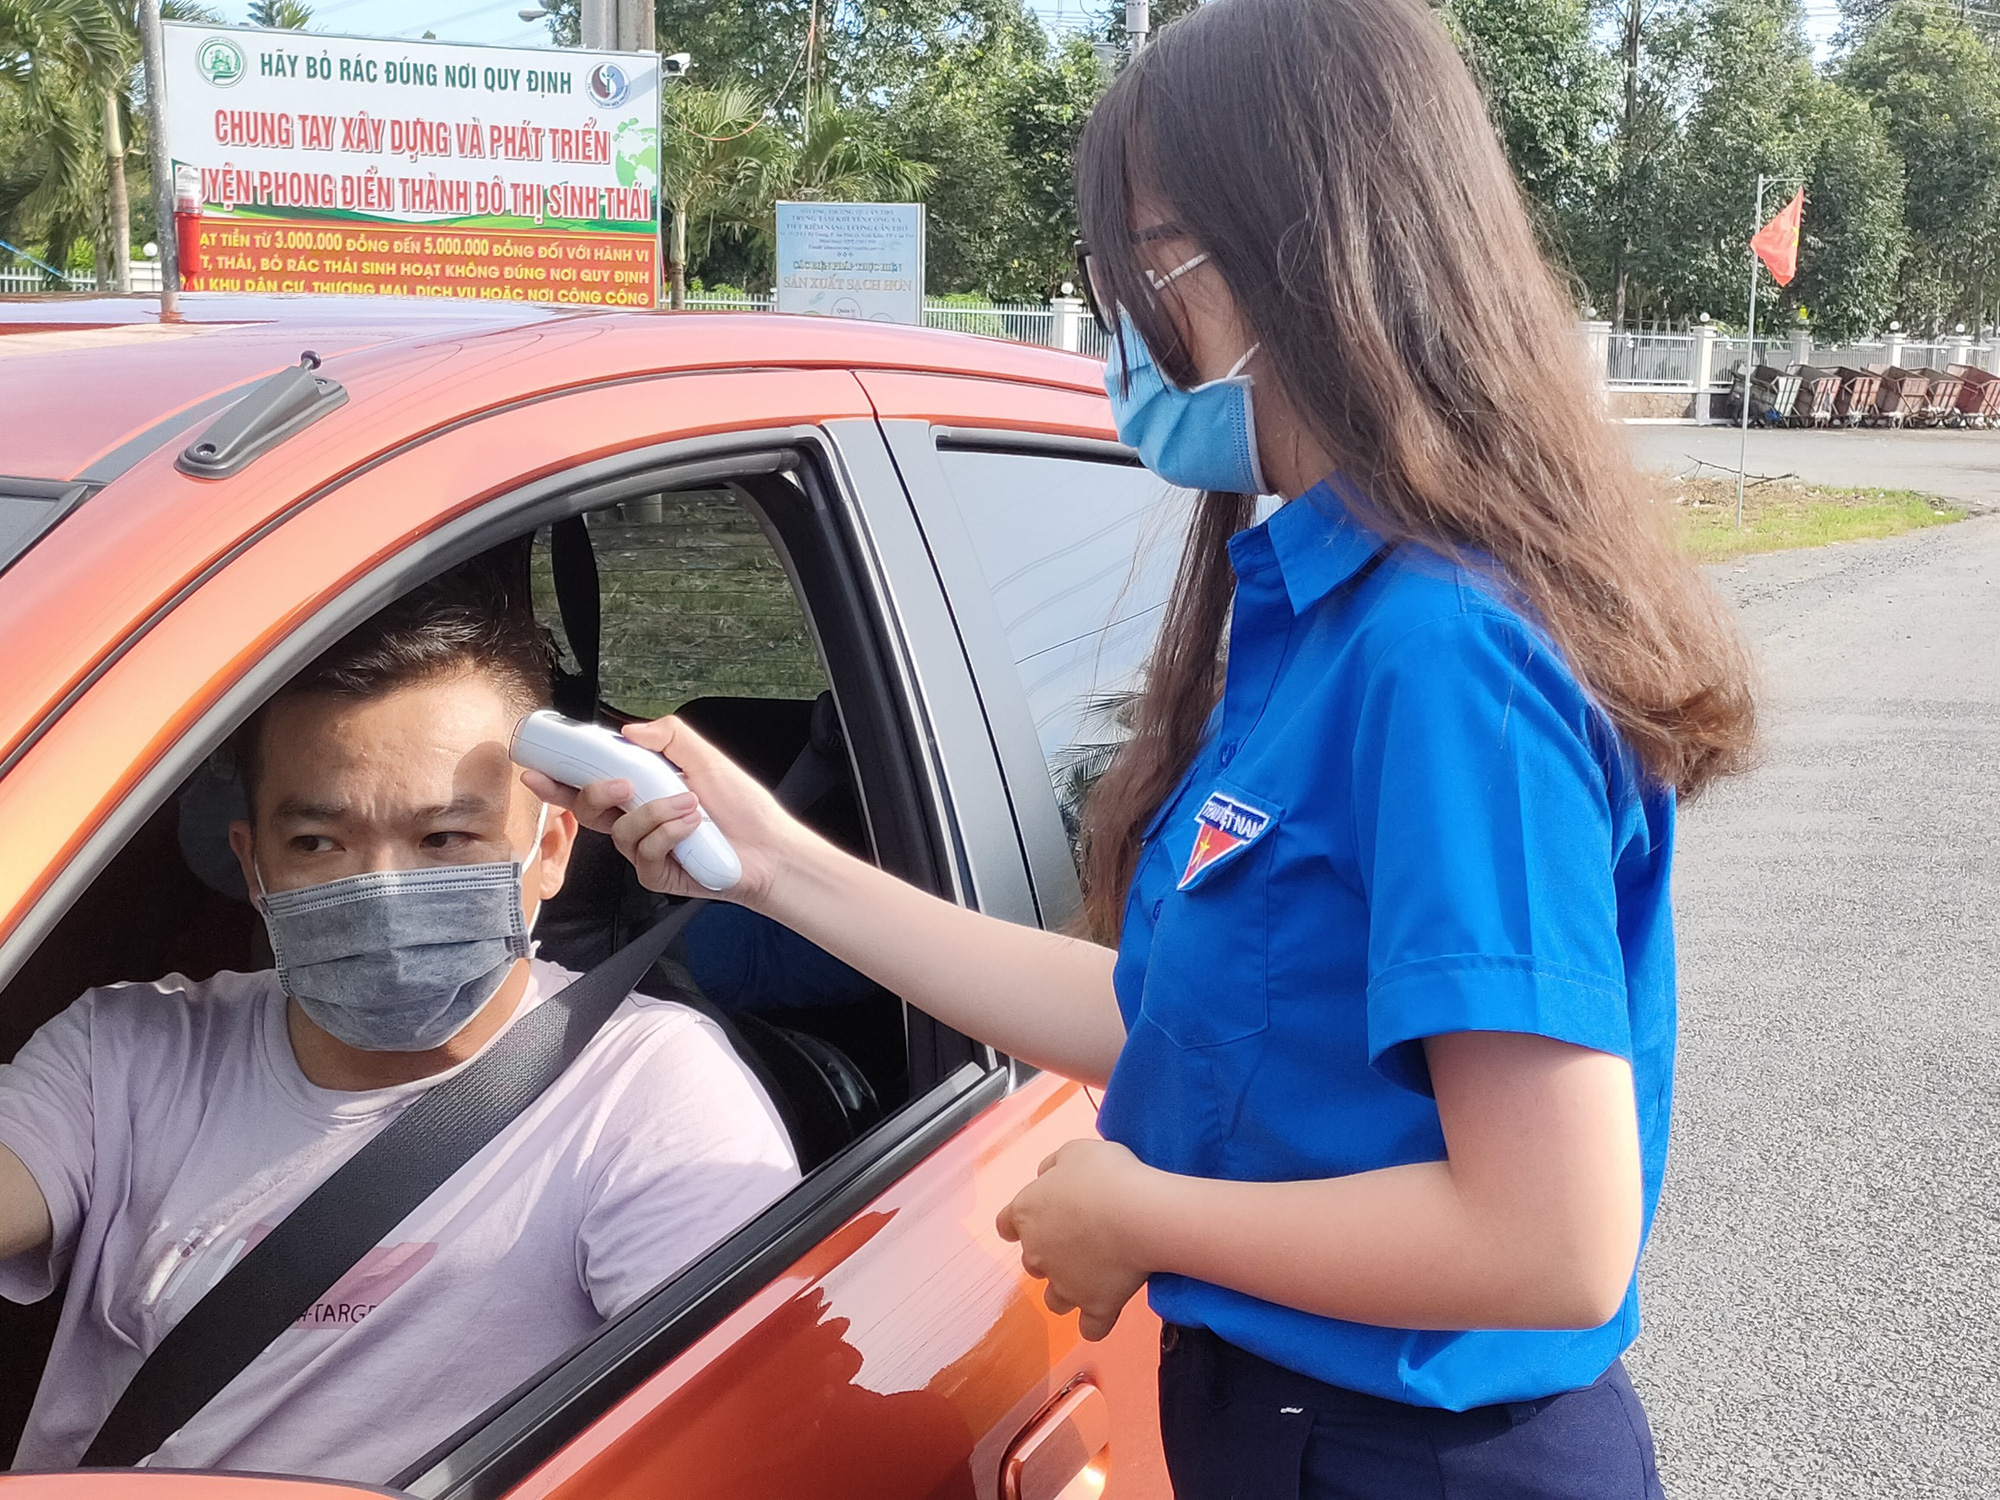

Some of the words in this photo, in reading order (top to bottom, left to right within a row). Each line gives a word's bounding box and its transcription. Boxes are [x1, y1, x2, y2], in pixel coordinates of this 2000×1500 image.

[260, 48, 298, 78] HÃY
[306, 50, 332, 80] BỎ
[340, 53, 377, 83] RÁC
[385, 56, 437, 86] ĐÚNG
[445, 63, 476, 89] NƠI
[484, 67, 520, 92] QUY
[526, 70, 571, 98] ĐỊNH
[215, 109, 293, 148] CHUNG
[298, 114, 335, 149] TAY
[341, 110, 385, 152] XÂY
[391, 116, 449, 162] DỰNG
[456, 116, 484, 158] VÀ
[489, 119, 545, 160] PHÁT
[550, 116, 610, 164] TRIỂN
[258, 170, 335, 207] PHONG
[400, 171, 470, 215] THÀNH
[475, 175, 506, 216] ĐÔ
[510, 182, 543, 224] THỊ
[604, 182, 650, 220] THÁI
[275, 231, 342, 251] 3.000.000
[393, 235, 421, 254] ĐẾN
[424, 237, 489, 256] 5.000.000
[594, 245, 632, 262] HÀNH
[635, 249, 649, 263] VI
[287, 256, 320, 272] RÁC
[361, 261, 396, 275] SINH
[401, 263, 441, 279] HOẠT
[445, 259, 500, 278] KHÔNG
[503, 264, 546, 280] ĐÚNG
[550, 267, 576, 282] NƠI
[580, 269, 611, 282] QUY
[614, 270, 649, 286] ĐỊNH
[810, 273, 844, 290] XUẤT
[847, 279, 882, 292] SẠCH
[209, 278, 240, 292] KHU
[245, 276, 277, 292] DÂN
[558, 287, 601, 303] CÔNG
